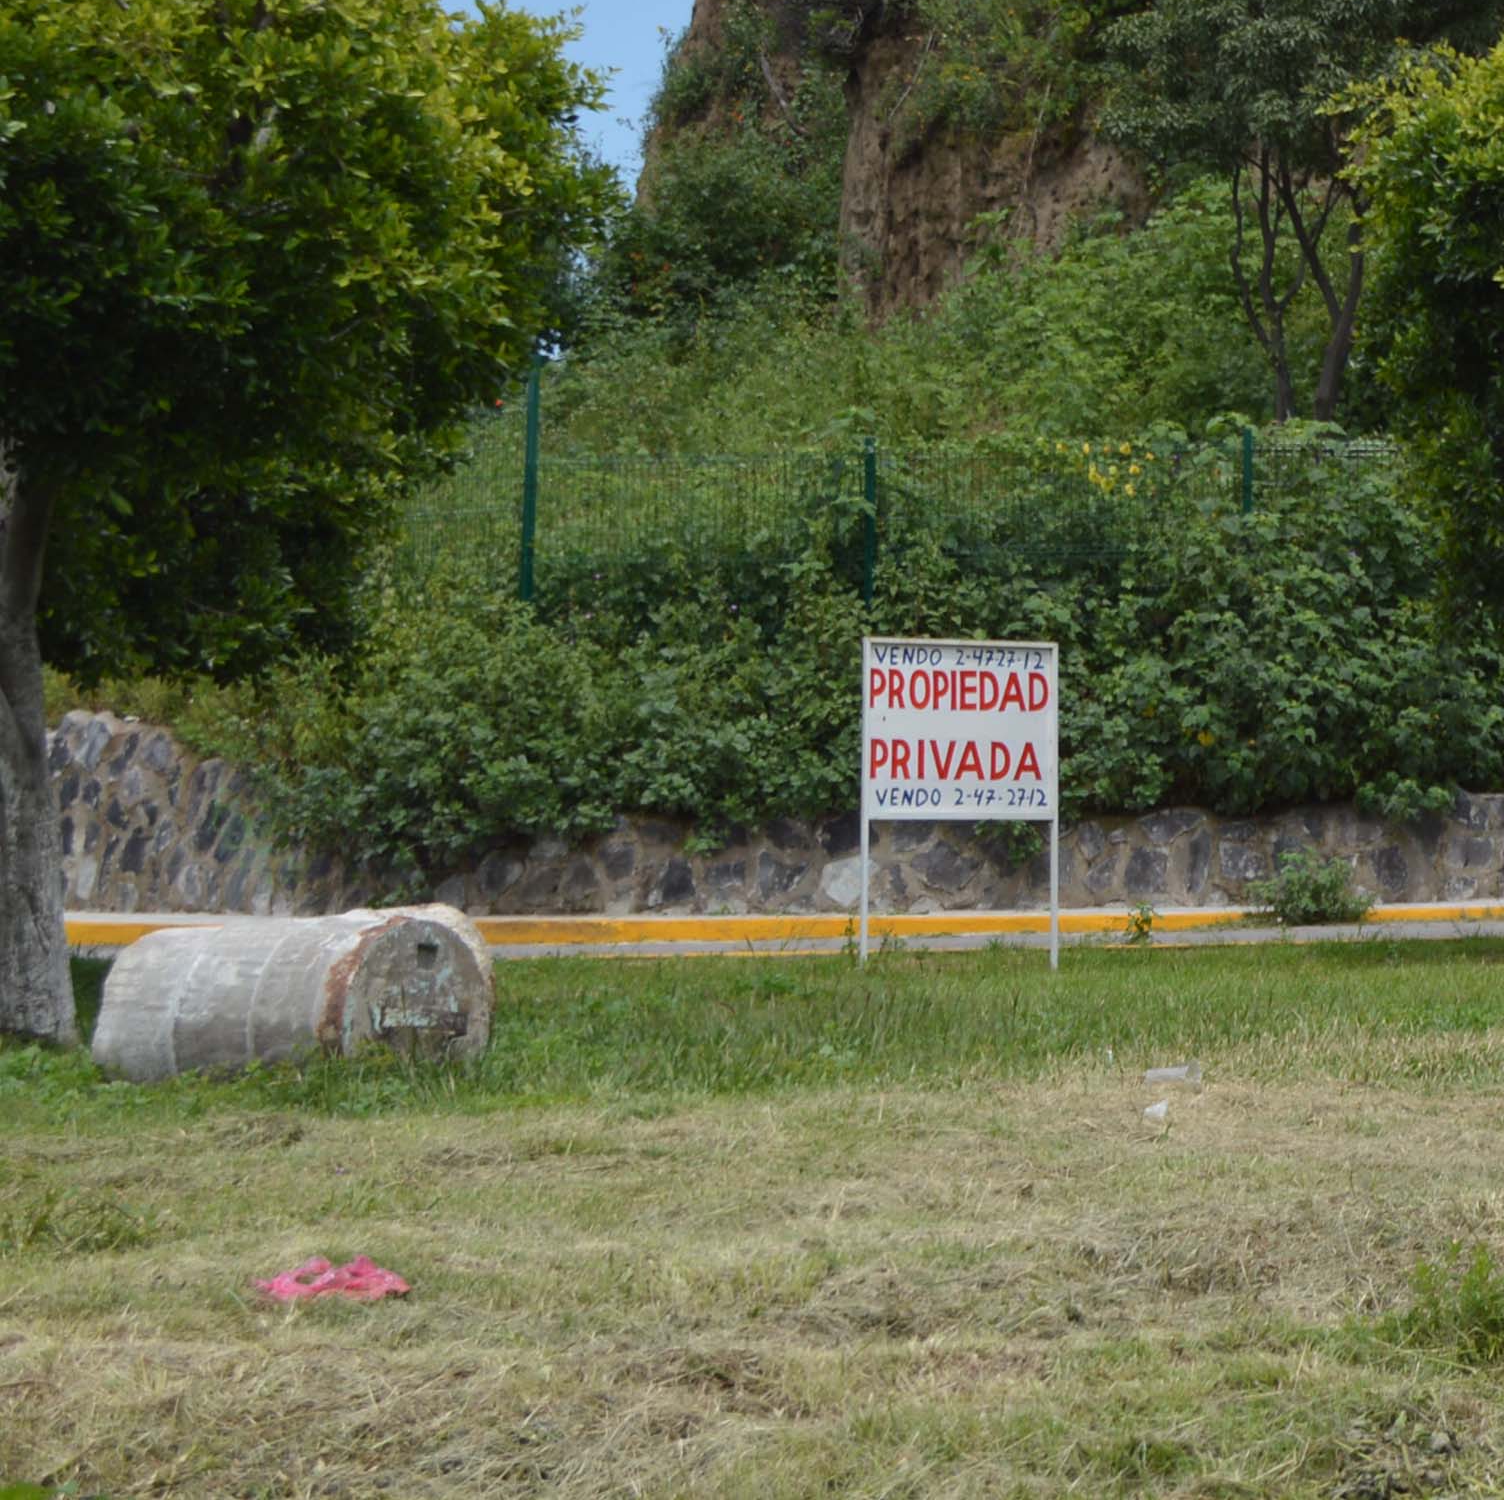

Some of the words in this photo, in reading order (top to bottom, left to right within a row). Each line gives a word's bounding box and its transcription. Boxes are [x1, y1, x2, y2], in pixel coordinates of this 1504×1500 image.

[875, 647, 942, 666] VENDO
[870, 669, 1049, 712] PROPIEDAD
[870, 739, 1041, 781] PRIVADA
[876, 788, 941, 807] VENDO
